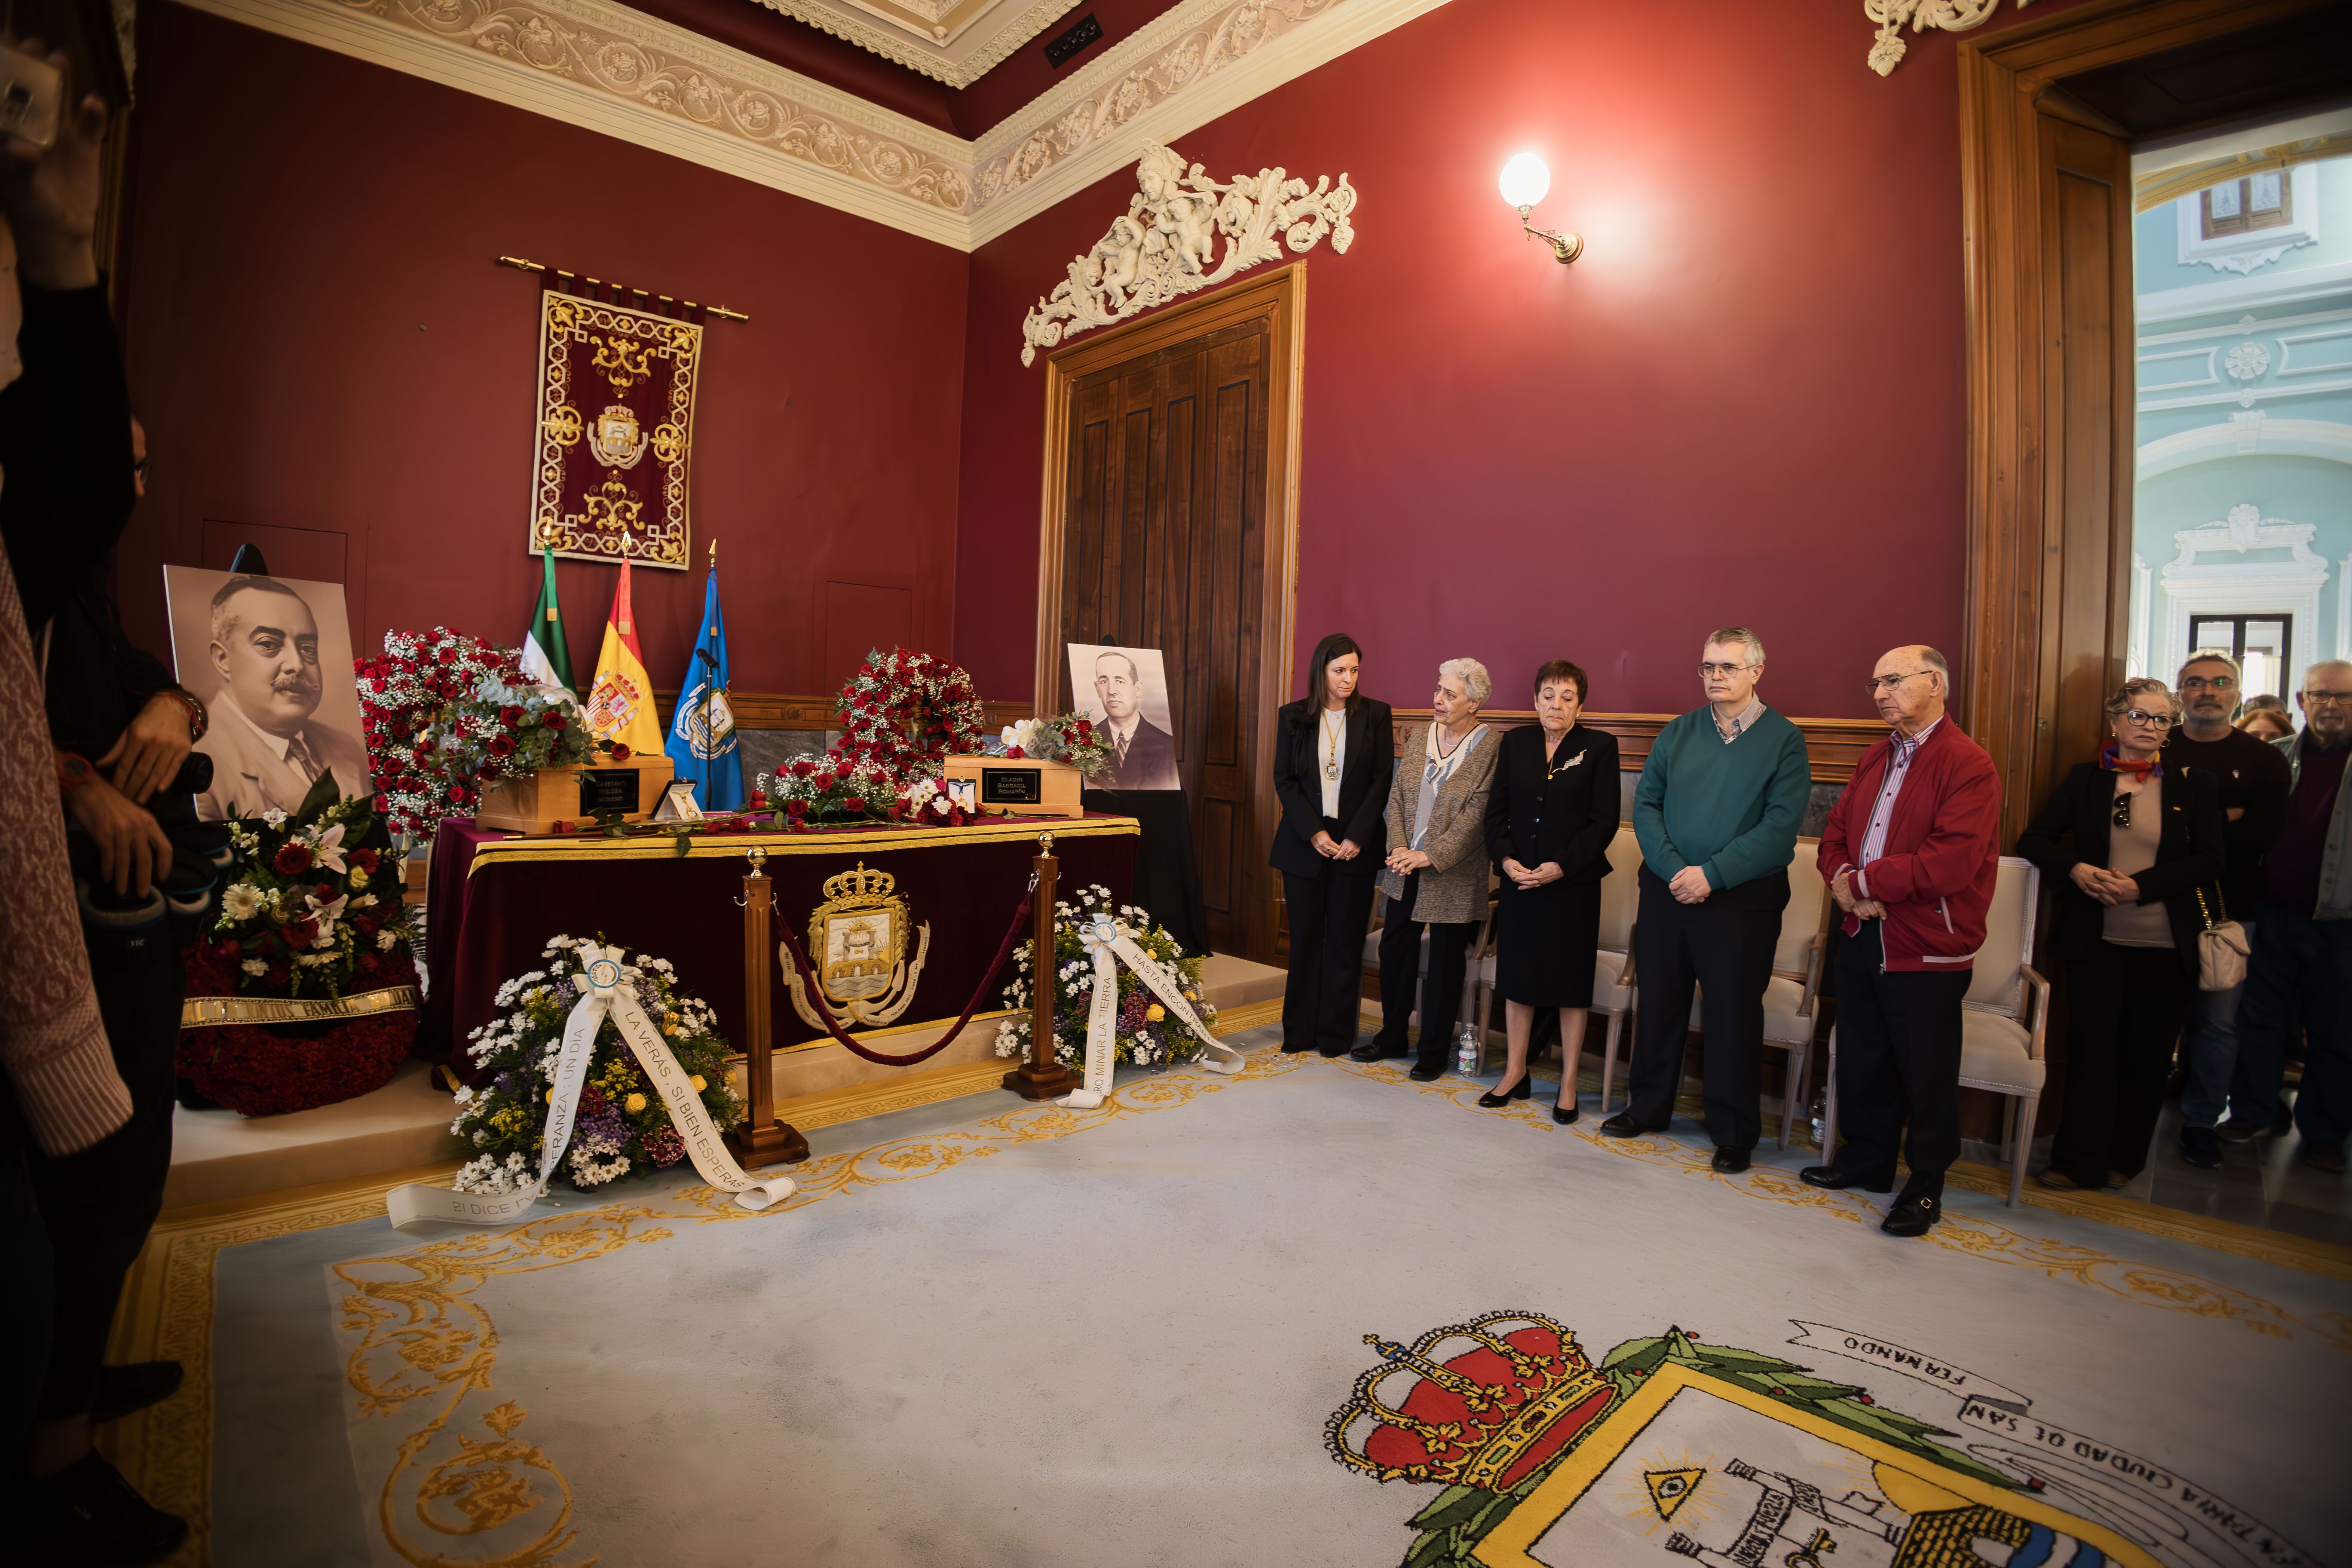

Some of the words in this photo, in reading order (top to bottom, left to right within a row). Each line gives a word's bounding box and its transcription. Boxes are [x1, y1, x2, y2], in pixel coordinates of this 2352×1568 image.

[1133, 953, 1162, 984] HASTA
[1099, 977, 1111, 1019] TIERRA
[569, 1028, 585, 1054] DÍA
[1098, 1023, 1107, 1039] LA
[563, 1057, 578, 1081] UN
[1095, 1040, 1107, 1076] MINAR
[625, 1011, 641, 1031] LA
[638, 1031, 671, 1078] VERÁS
[671, 1086, 685, 1102] SI
[679, 1103, 703, 1138] BIEN
[697, 1138, 745, 1188] ESPERAS
[1844, 1335, 1967, 1385] FERNANDO
[1965, 1401, 2019, 1432] SAN
[2034, 1424, 2067, 1447] DE
[2074, 1441, 2174, 1490] CIUDAD
